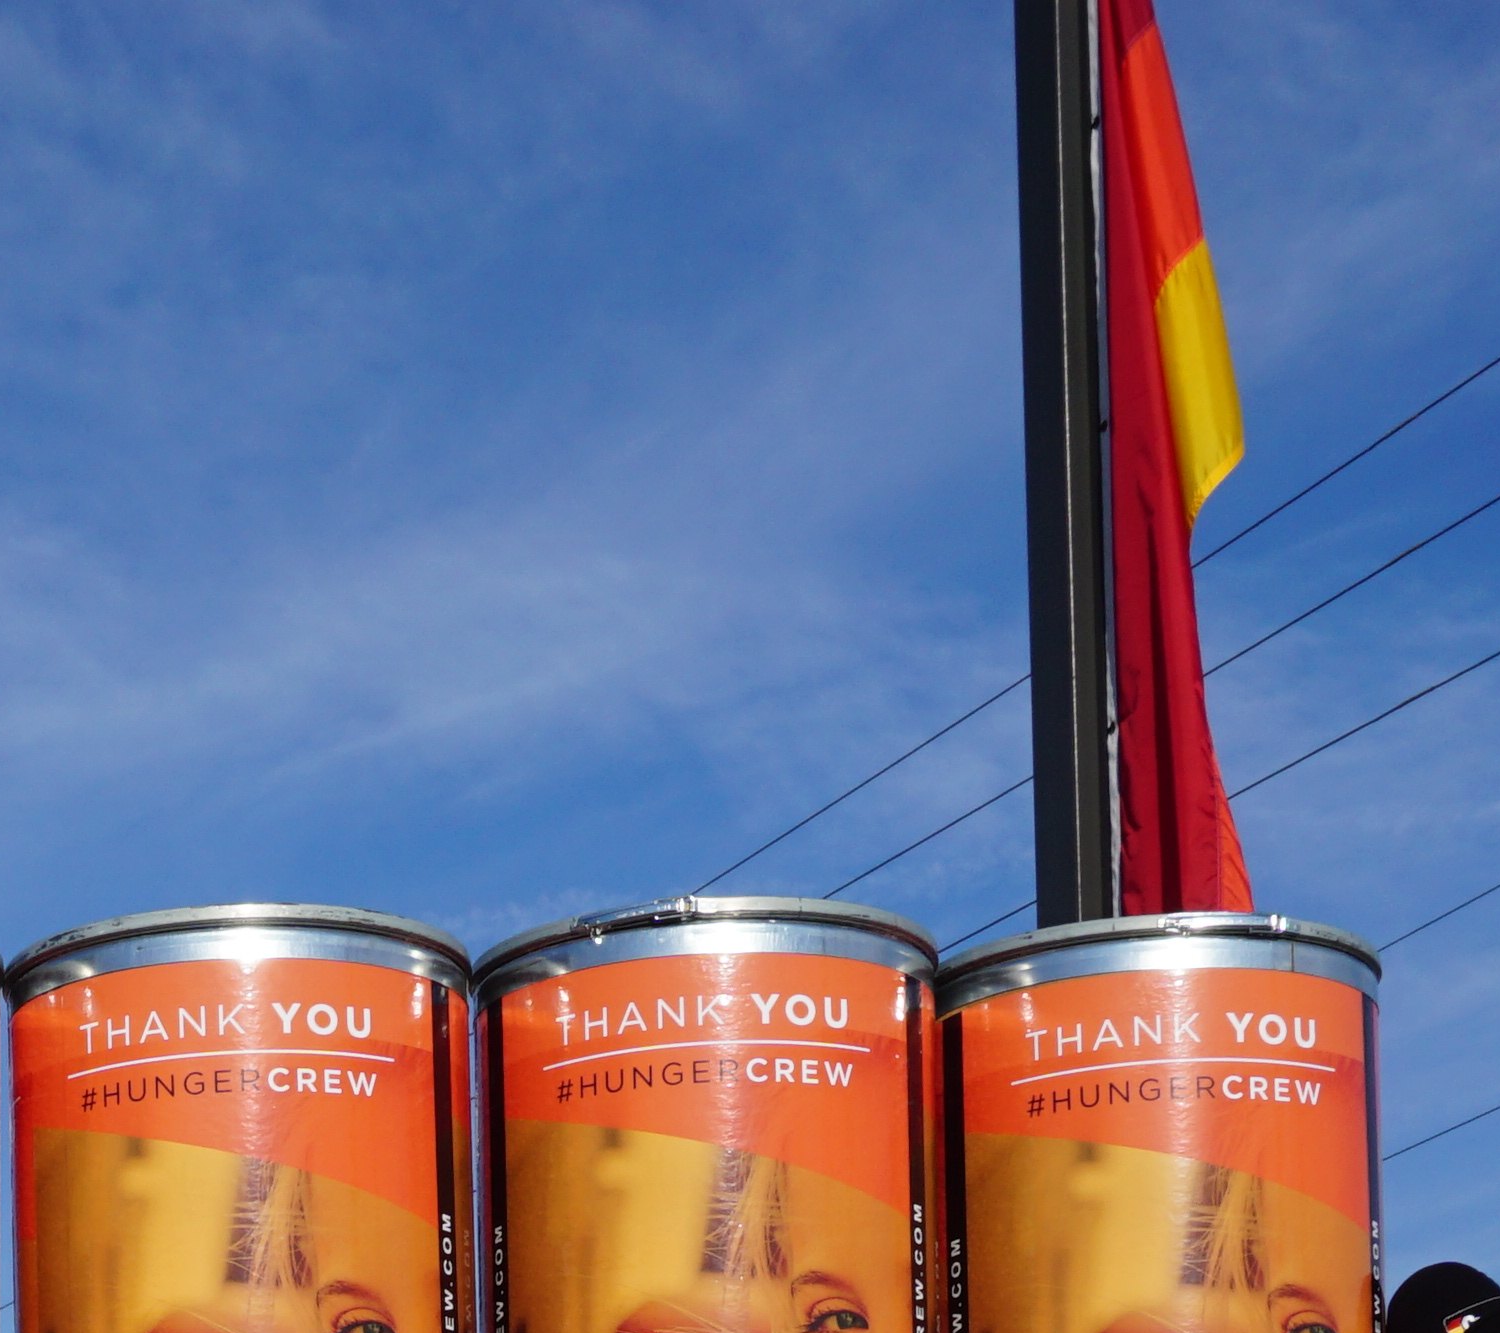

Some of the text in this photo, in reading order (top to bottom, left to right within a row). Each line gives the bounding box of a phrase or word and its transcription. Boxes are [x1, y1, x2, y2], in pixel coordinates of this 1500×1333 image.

[79, 1002, 372, 1054] THANK YOU
[555, 993, 849, 1047] THANK YOU
[1025, 1012, 1317, 1062] THANK YOU
[80, 1067, 378, 1112] #HUNGERCREW
[557, 1058, 853, 1104] #HUNGERCREW
[1027, 1075, 1322, 1117] #HUNGERCREW
